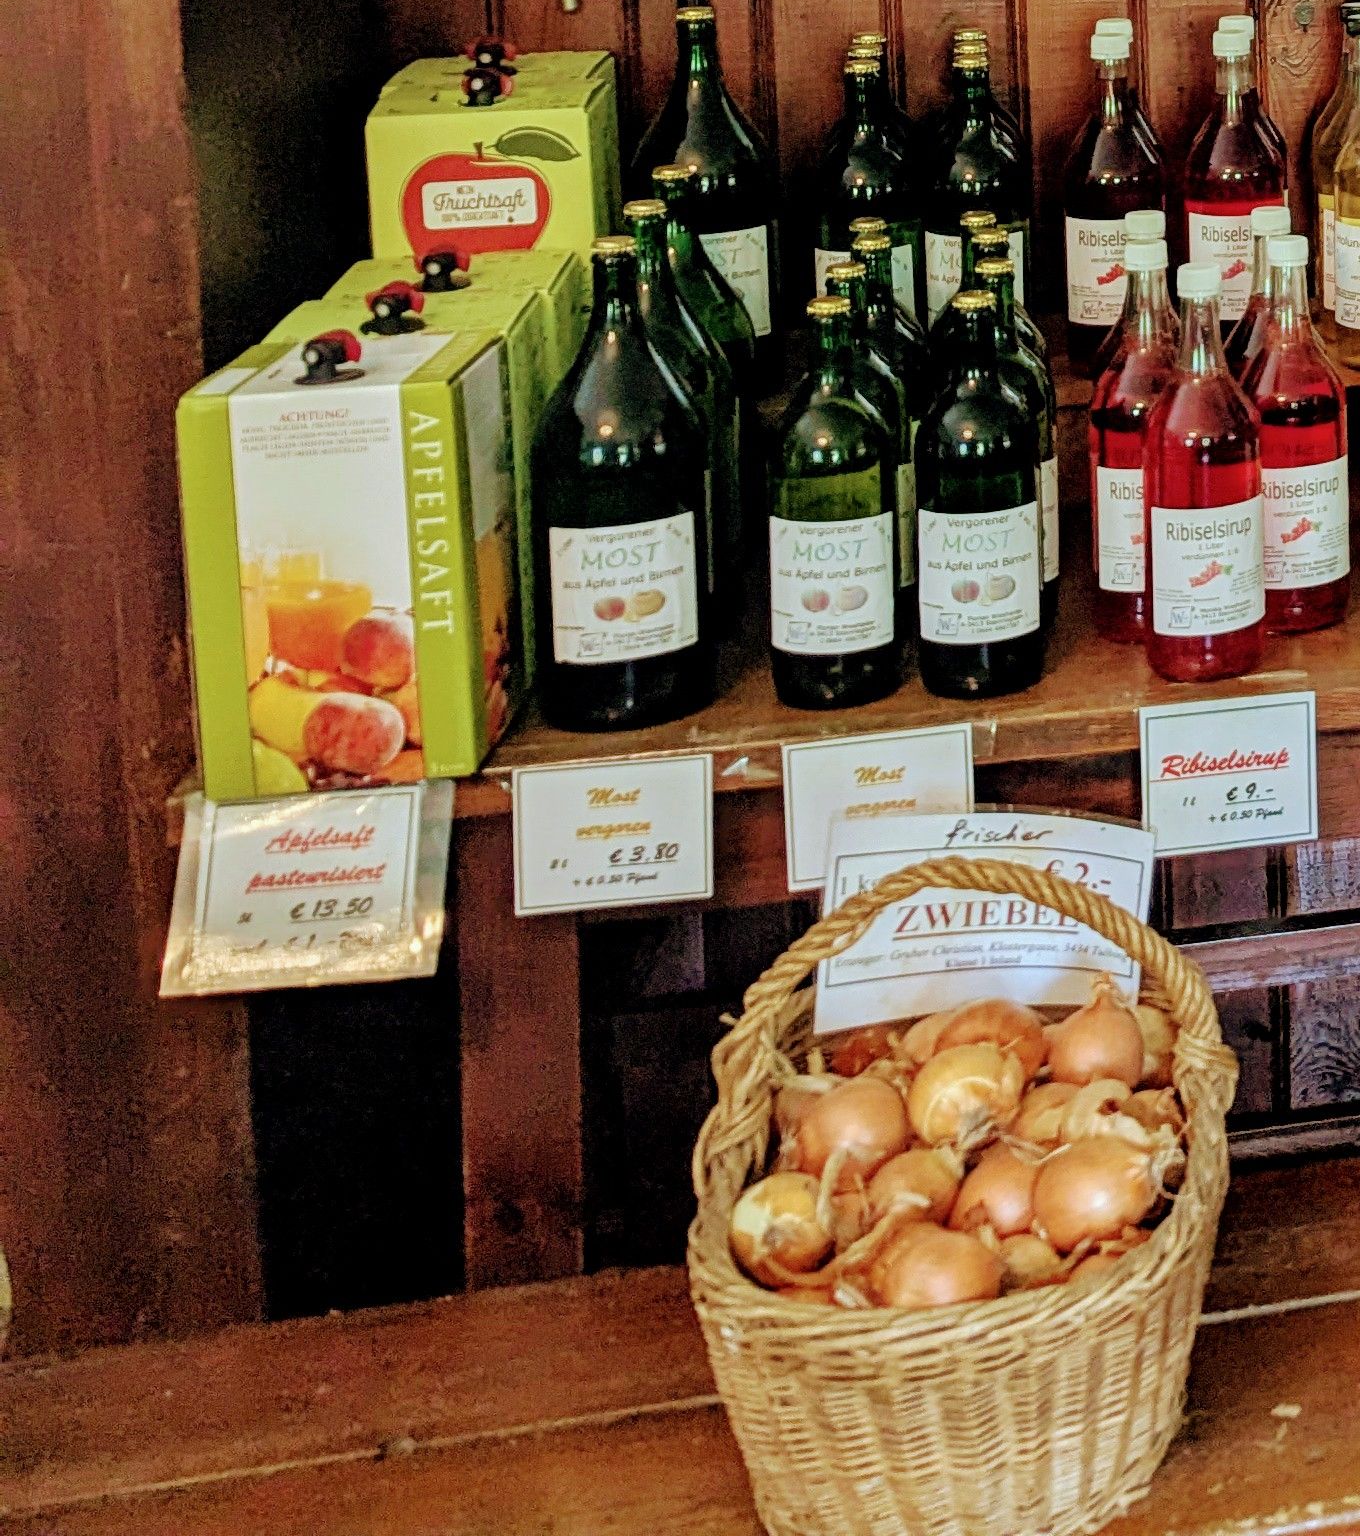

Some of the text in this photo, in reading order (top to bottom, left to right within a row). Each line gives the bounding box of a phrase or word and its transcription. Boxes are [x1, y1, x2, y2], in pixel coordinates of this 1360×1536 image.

[433, 188, 527, 212] Fruchtsaft
[1078, 229, 1127, 247] Ribisels
[1261, 476, 1339, 501] Ribiselsirup
[408, 410, 455, 635] APFELSAFT
[799, 523, 864, 538] Vergorener
[947, 514, 1010, 528] Vergorener
[1165, 516, 1252, 542] Ribiselsirup
[792, 537, 869, 562] MOST
[941, 527, 1016, 554] MOST
[580, 540, 663, 571] MOST
[976, 558, 999, 570] und
[620, 573, 645, 586] und
[827, 567, 851, 579] und
[1160, 747, 1290, 779] Ribiselsirup
[855, 765, 905, 783] Most
[586, 785, 641, 806] Most
[1226, 782, 1274, 802] € 9.-
[1255, 806, 1284, 821] Pfand
[264, 824, 376, 853] Apfelsaft
[576, 821, 652, 840] vergoren
[944, 819, 1054, 848] frischer
[609, 847, 624, 864] €
[245, 863, 387, 894] pasteurisiert
[290, 902, 304, 920] €
